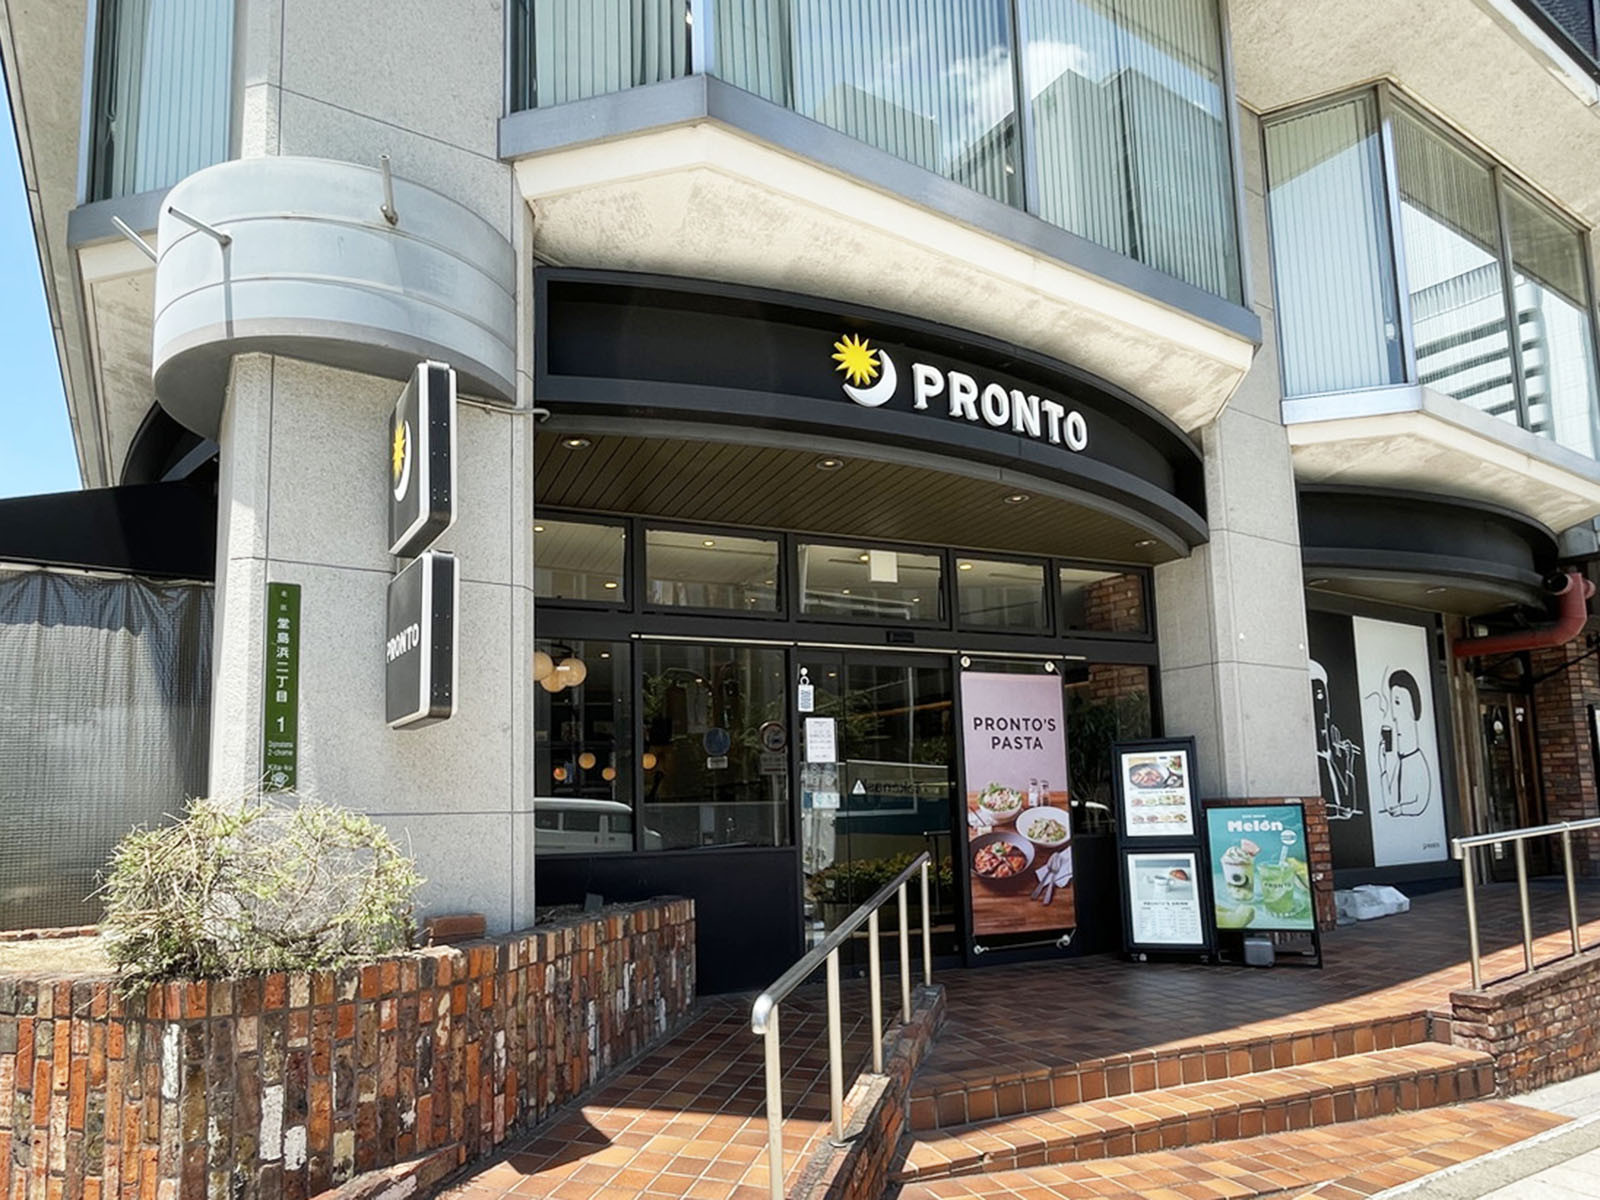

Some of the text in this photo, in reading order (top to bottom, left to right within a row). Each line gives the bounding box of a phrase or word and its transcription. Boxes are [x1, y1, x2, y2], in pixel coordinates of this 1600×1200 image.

[912, 363, 1088, 451] PRONTO
[386, 623, 420, 664] PRONTO
[275, 617, 290, 703] 堂島浜二丁目
[276, 716, 285, 733] 1
[973, 717, 1056, 731] PRONTO'S
[991, 736, 1043, 750] PASTA
[1227, 819, 1284, 832] Melón
